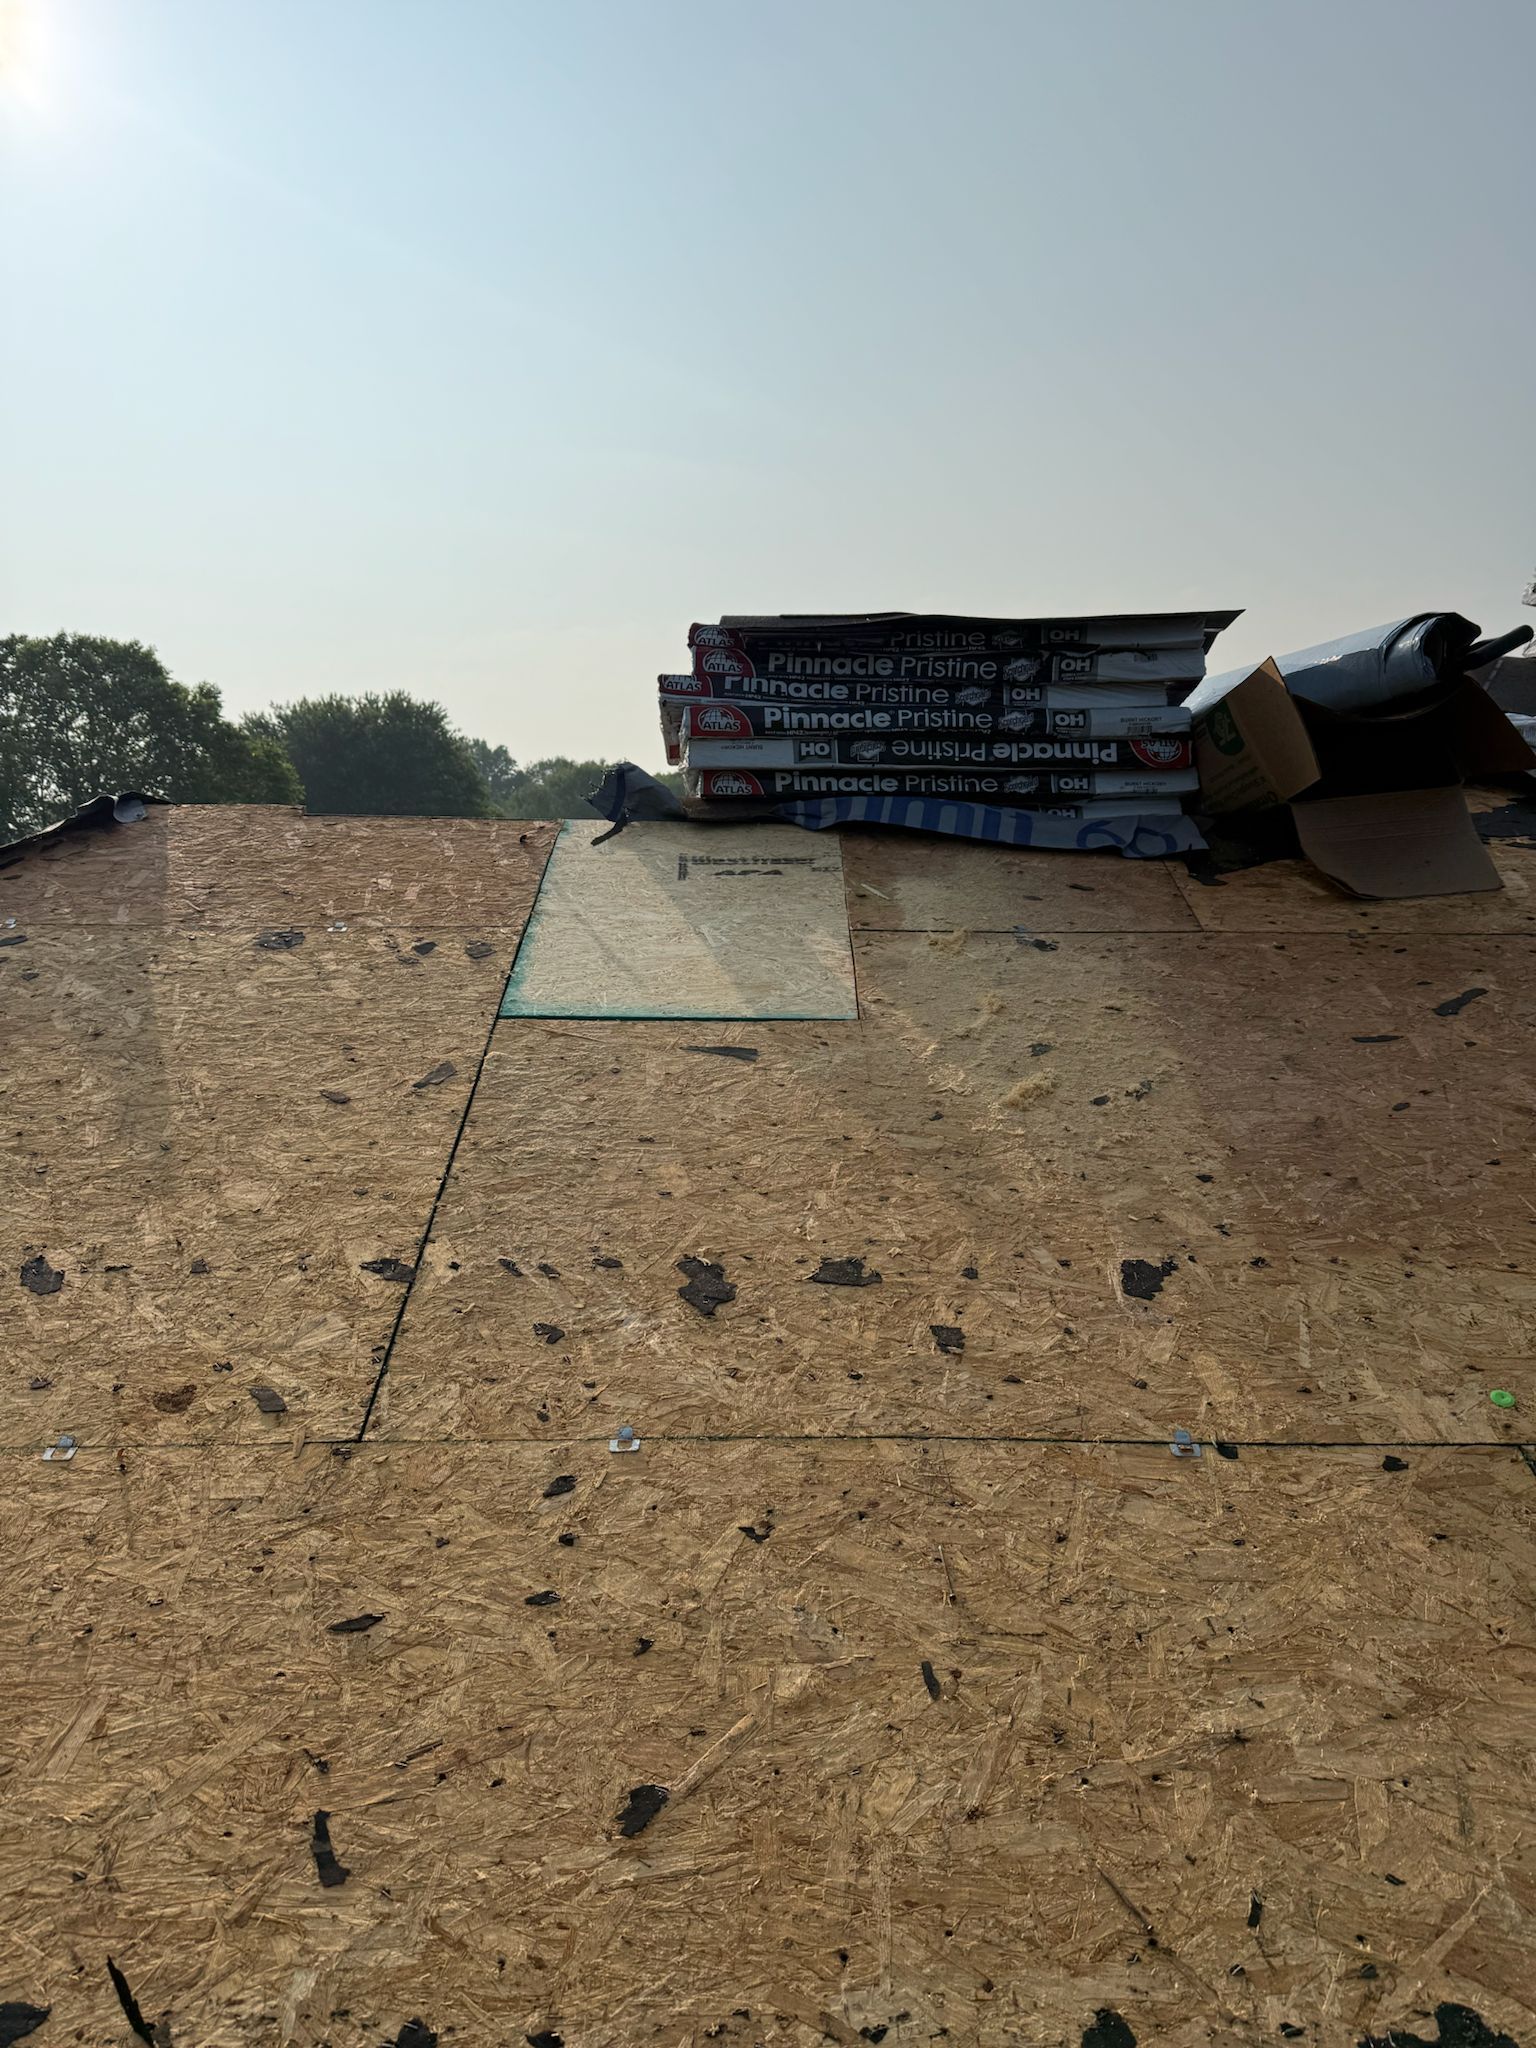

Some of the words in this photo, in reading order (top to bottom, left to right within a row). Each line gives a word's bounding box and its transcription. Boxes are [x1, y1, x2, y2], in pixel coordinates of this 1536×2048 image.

[699, 637, 735, 646] ATLAS
[890, 629, 986, 649] Pristine
[1050, 629, 1080, 642] OH
[707, 662, 744, 673] ATLAS
[768, 652, 895, 676] Pinnacle
[900, 656, 998, 680] Pristine
[1060, 658, 1092, 672] OH
[666, 680, 702, 691] ATLAS
[724, 675, 849, 700] Pinnacle
[855, 683, 950, 704] Pristine
[1011, 686, 1040, 700] OH
[764, 706, 892, 729] Pinnacle
[897, 708, 993, 729] Pristine
[1055, 711, 1085, 727] OH
[702, 721, 741, 731] ATLAS
[891, 740, 986, 762] Pristine
[992, 742, 1118, 765] Pinnacle
[775, 771, 899, 793] Pinnacle
[905, 773, 998, 793] Pristine
[1059, 777, 1089, 791] OH
[714, 784, 752, 795] ATLAS
